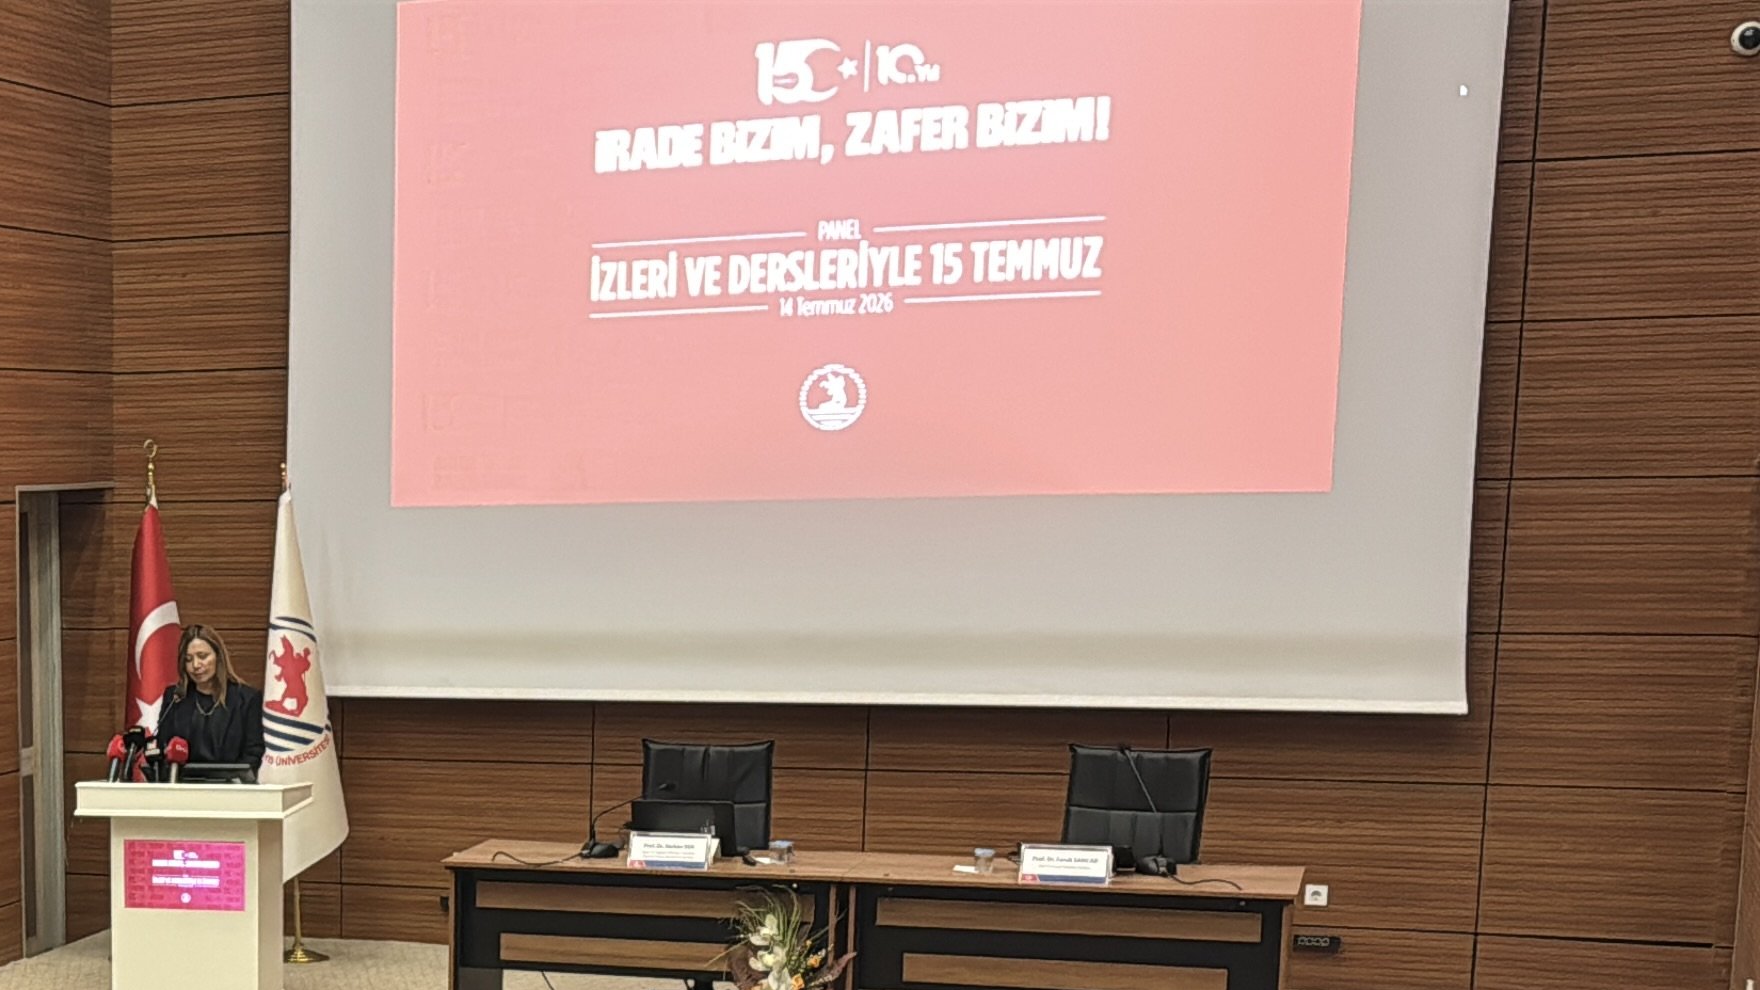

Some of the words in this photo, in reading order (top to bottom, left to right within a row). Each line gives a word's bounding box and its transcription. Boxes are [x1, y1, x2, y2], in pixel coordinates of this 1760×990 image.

[709, 114, 835, 166] BİZİM,
[844, 104, 970, 157] ZAFER
[975, 95, 1111, 148] BİZİM!
[817, 218, 862, 241] PANEL
[590, 250, 678, 302] İZLERİ
[684, 255, 722, 297] VE
[727, 239, 923, 295] DERSLERİYLE
[929, 242, 963, 285] 15
[969, 235, 1104, 283] TEMMUZ
[779, 297, 794, 317] 14
[796, 296, 857, 317] Temmuz
[858, 291, 894, 315] 2026
